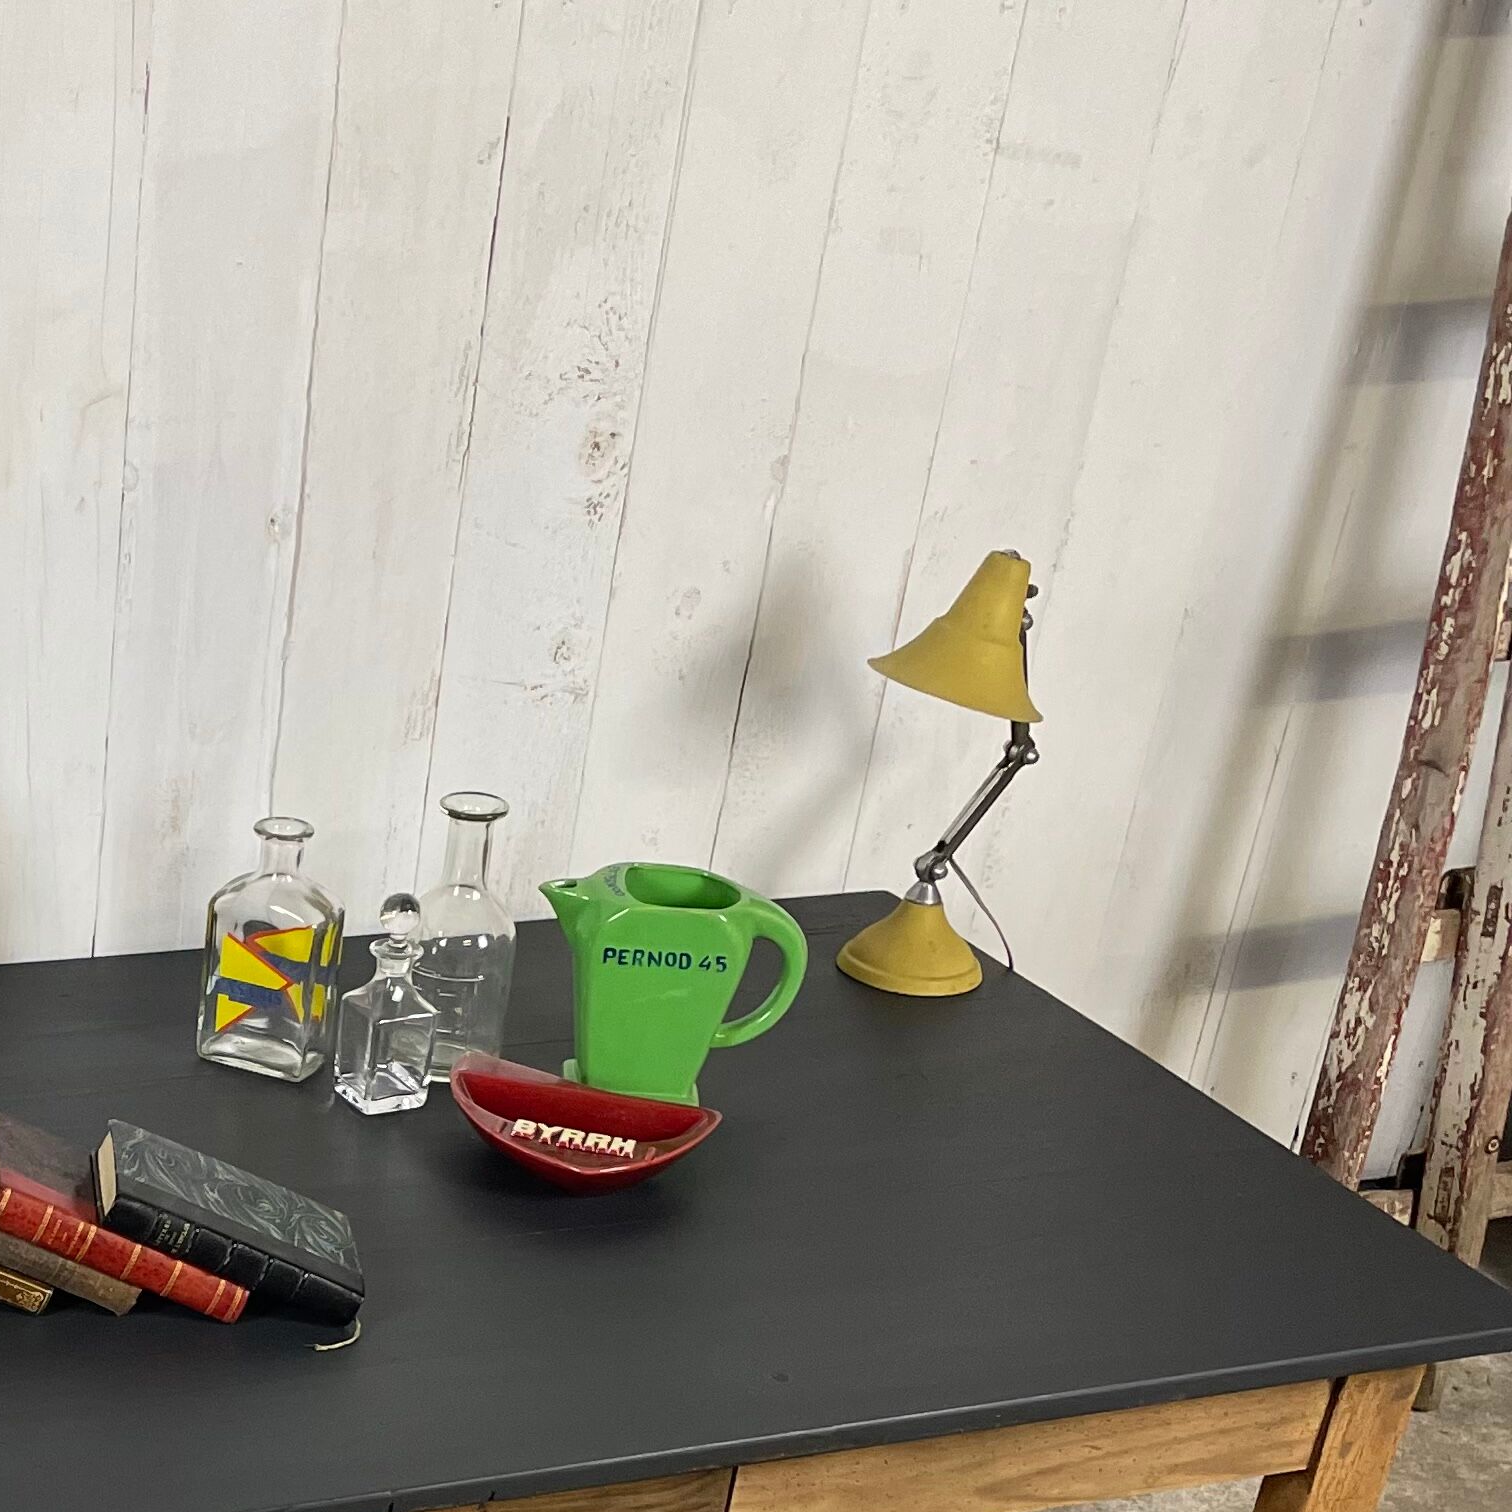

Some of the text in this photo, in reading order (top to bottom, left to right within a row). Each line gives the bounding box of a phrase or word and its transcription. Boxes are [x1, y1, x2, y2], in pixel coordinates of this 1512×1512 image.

[602, 947, 727, 973] PERNOD 45
[510, 1118, 637, 1159] BYRRH
